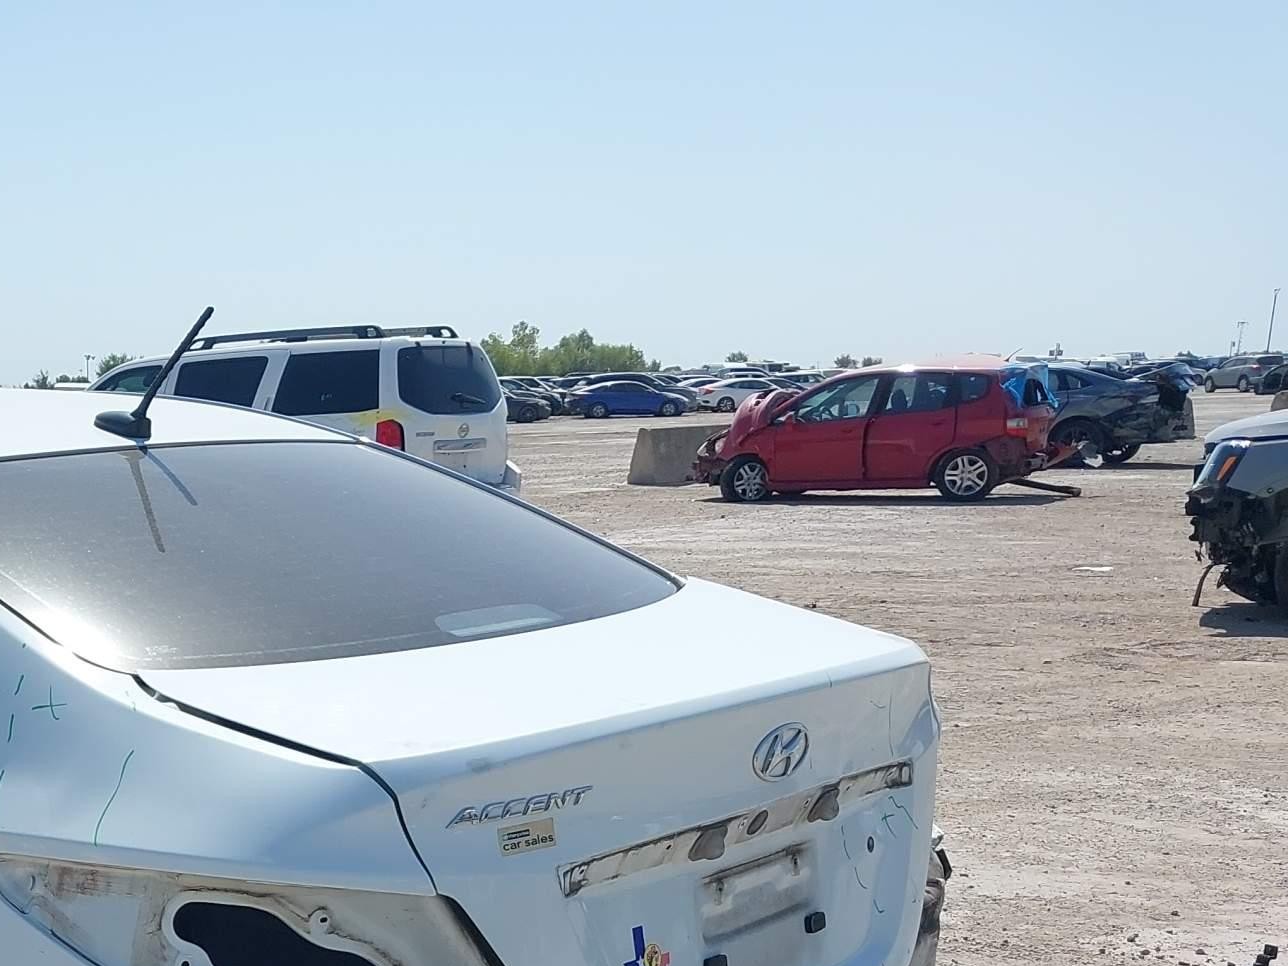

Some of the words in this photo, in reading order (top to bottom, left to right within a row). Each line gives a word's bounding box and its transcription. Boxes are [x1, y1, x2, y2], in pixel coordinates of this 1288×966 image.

[445, 784, 593, 829] ACCENT
[502, 840, 522, 852] car
[524, 834, 554, 848] sales
